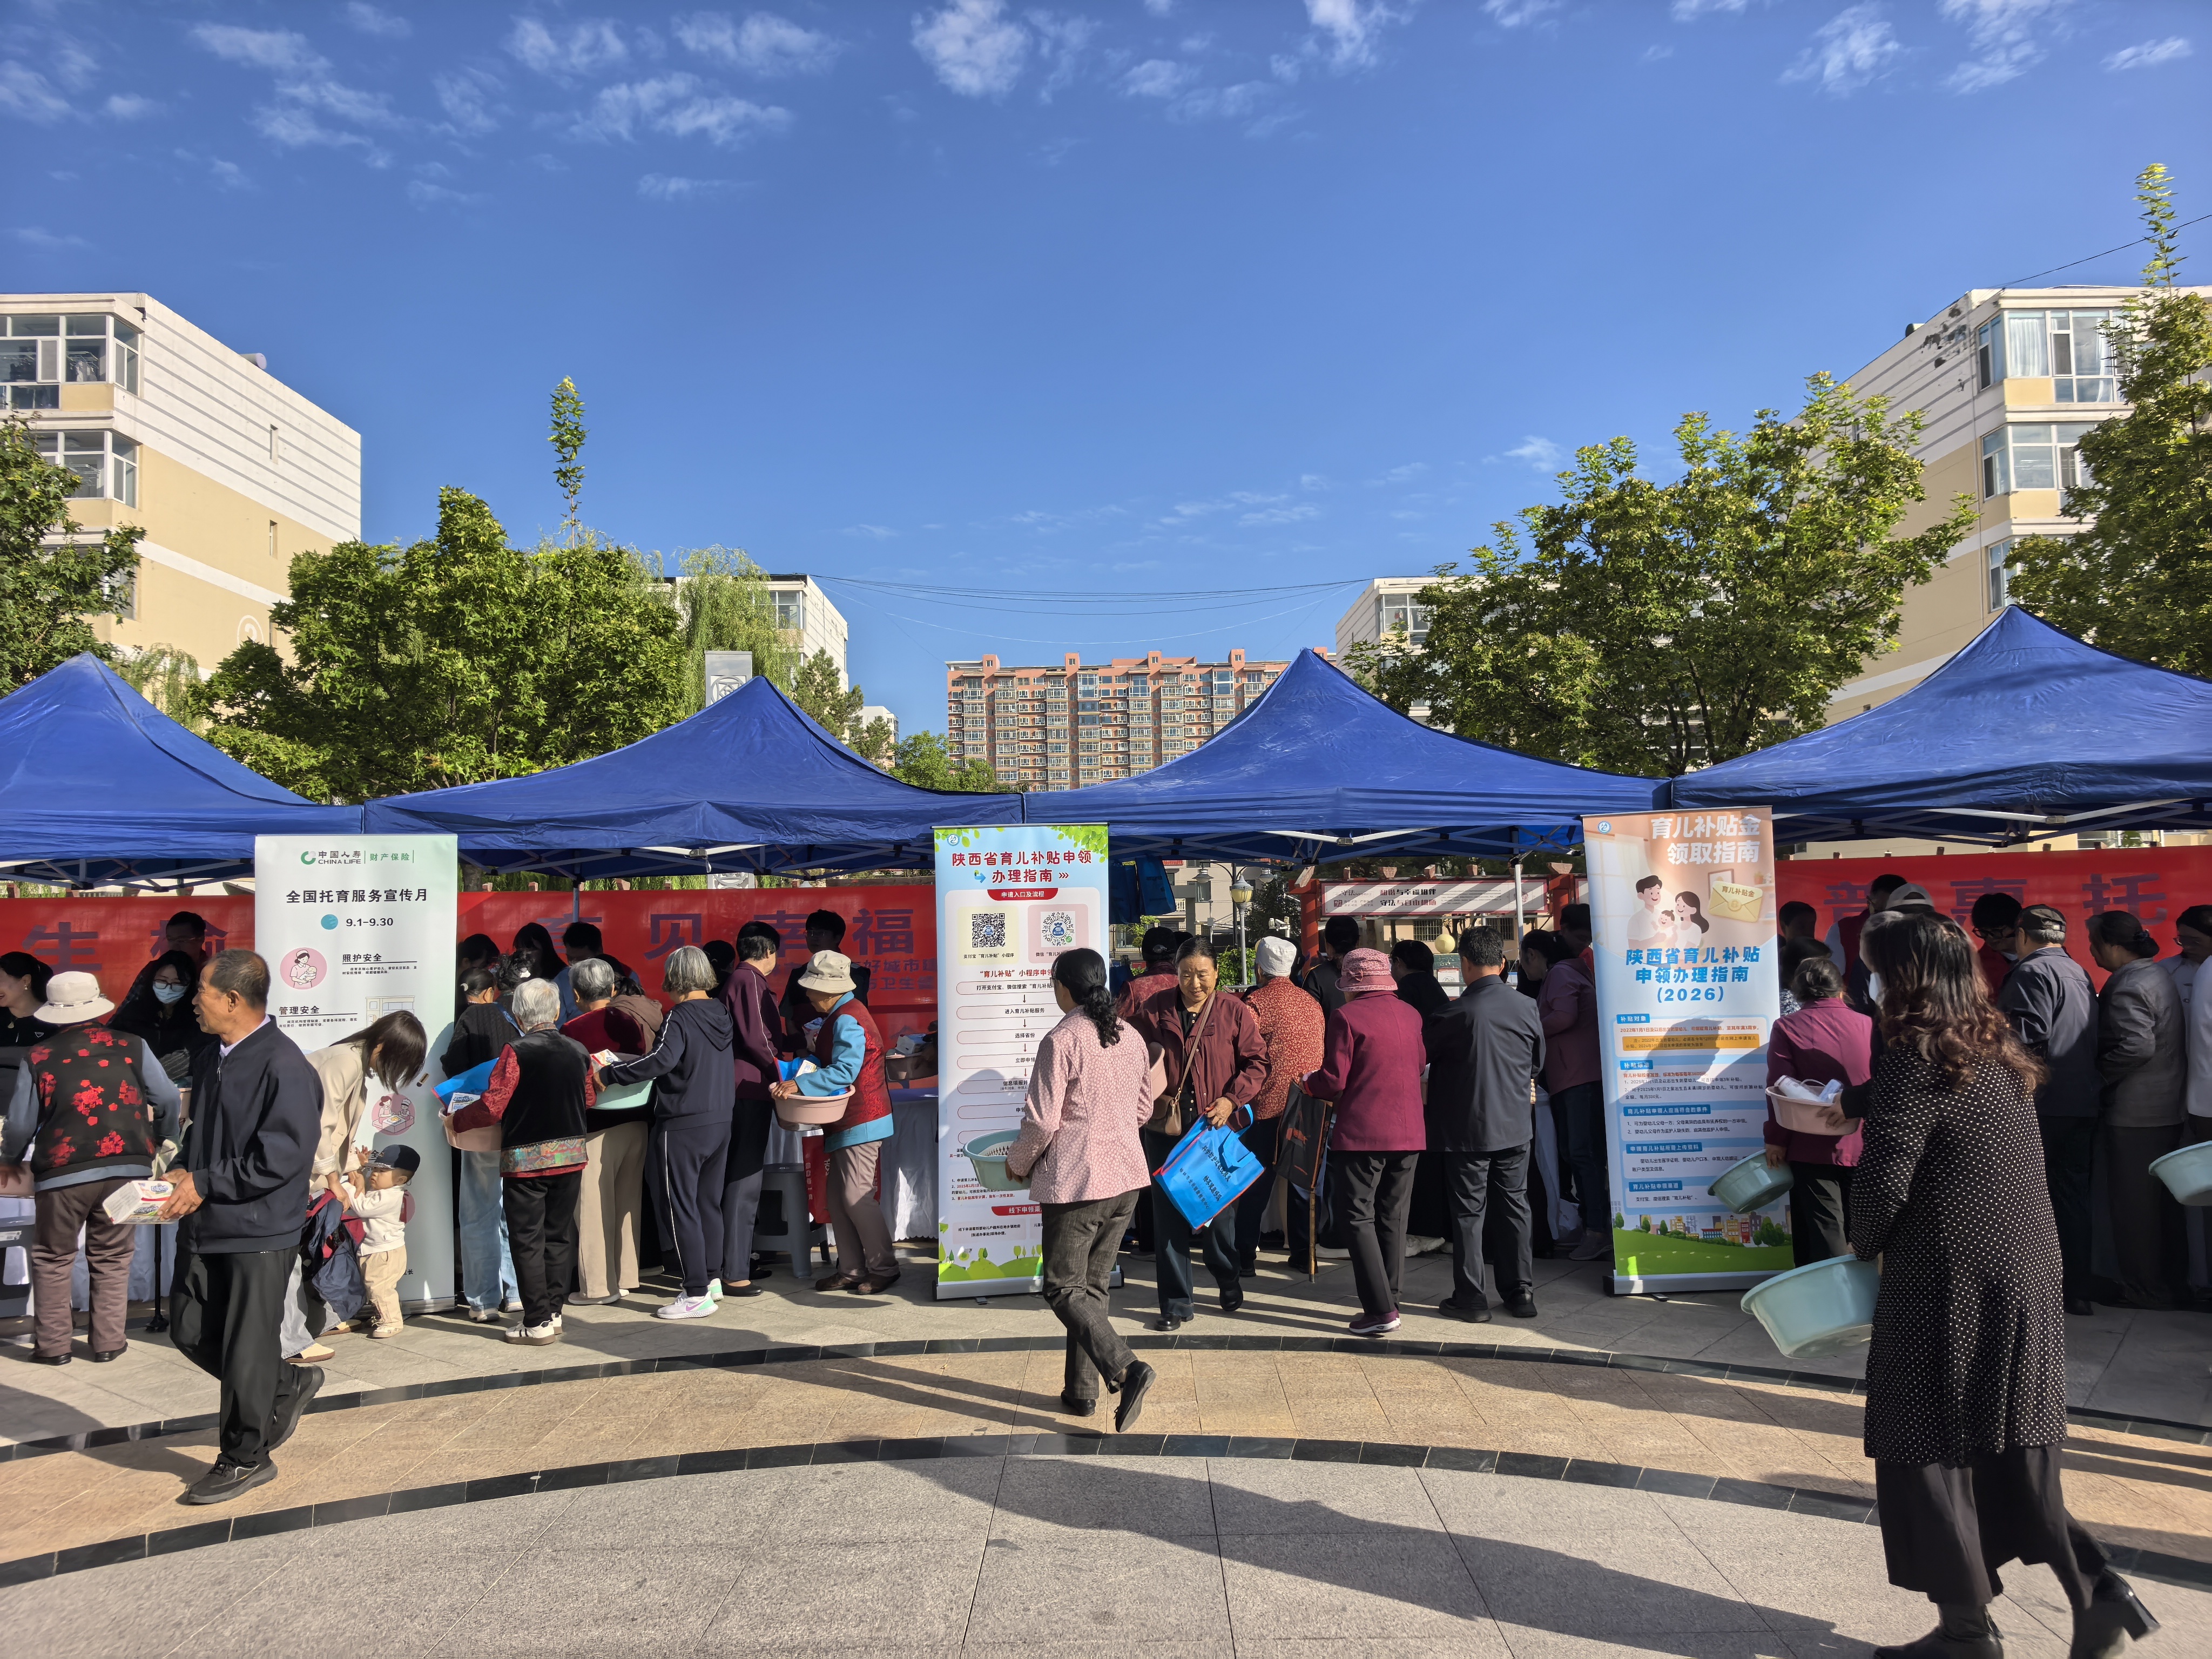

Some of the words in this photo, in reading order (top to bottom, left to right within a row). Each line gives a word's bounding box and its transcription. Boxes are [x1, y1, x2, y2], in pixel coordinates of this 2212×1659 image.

[1650, 814, 1761, 839] 育儿补贴金
[318, 851, 361, 859] 中国人寿
[369, 852, 410, 861] 财产保险
[952, 850, 1092, 867] 陕西省育儿补贴申领
[1667, 840, 1761, 865] 领取指南
[992, 868, 1053, 884] 办理指南
[286, 888, 428, 903] 全国托育服务宣传月
[1722, 885, 1755, 898] 育儿补贴金
[346, 918, 394, 927] 9.1-9.30
[342, 954, 382, 962] 照护安全
[1626, 946, 1761, 966] 陕西省育儿补贴
[1635, 966, 1749, 984] 申领办理指南
[279, 1006, 320, 1016] 管理安全
